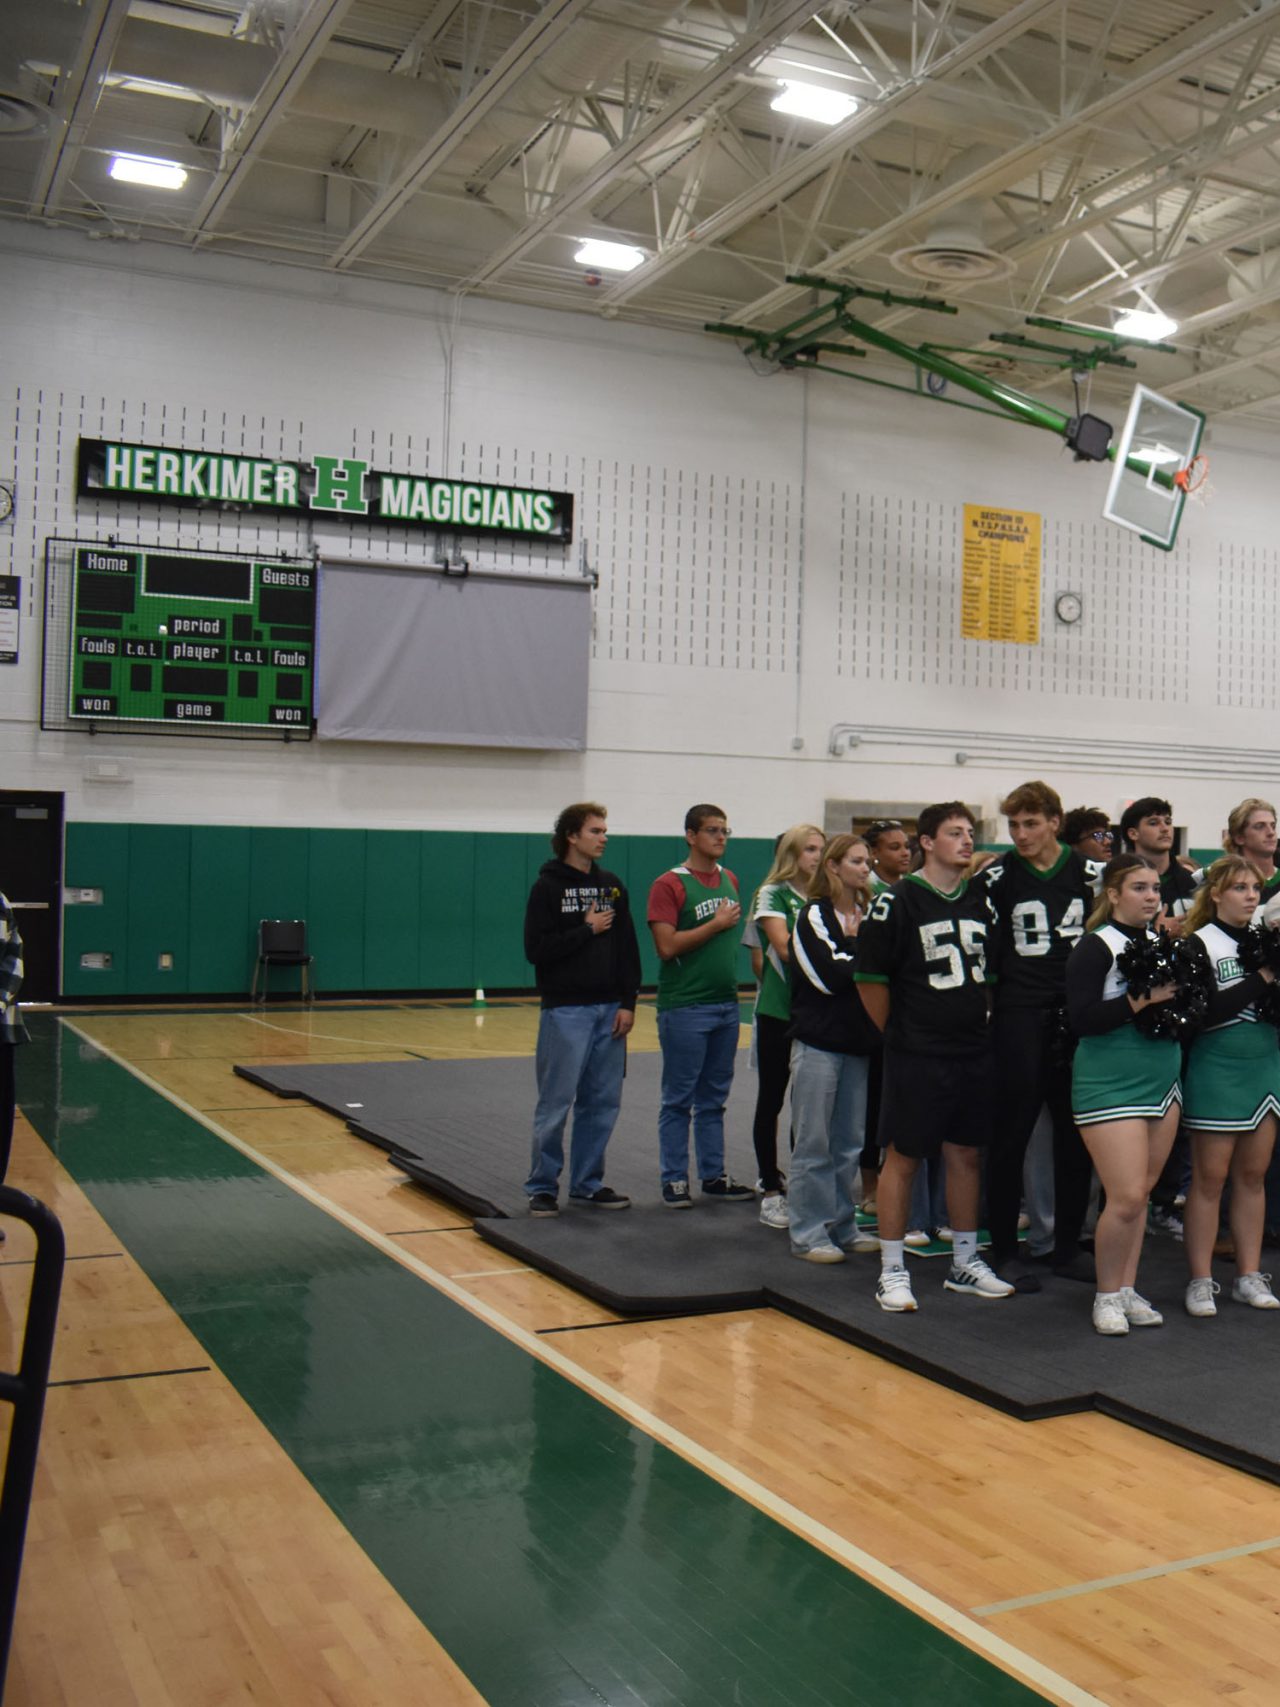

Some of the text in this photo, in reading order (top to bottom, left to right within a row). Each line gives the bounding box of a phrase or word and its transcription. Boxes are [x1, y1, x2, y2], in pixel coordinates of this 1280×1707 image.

[106, 446, 553, 532] HERKIMER H MAGICIANS
[87, 553, 128, 572] Home
[262, 568, 309, 587] Guests
[174, 619, 220, 634] period
[173, 644, 219, 665] player
[83, 698, 110, 711] won
[176, 703, 212, 717] game
[275, 709, 301, 721] won
[1011, 897, 1086, 957] 84
[918, 919, 988, 990] 55
